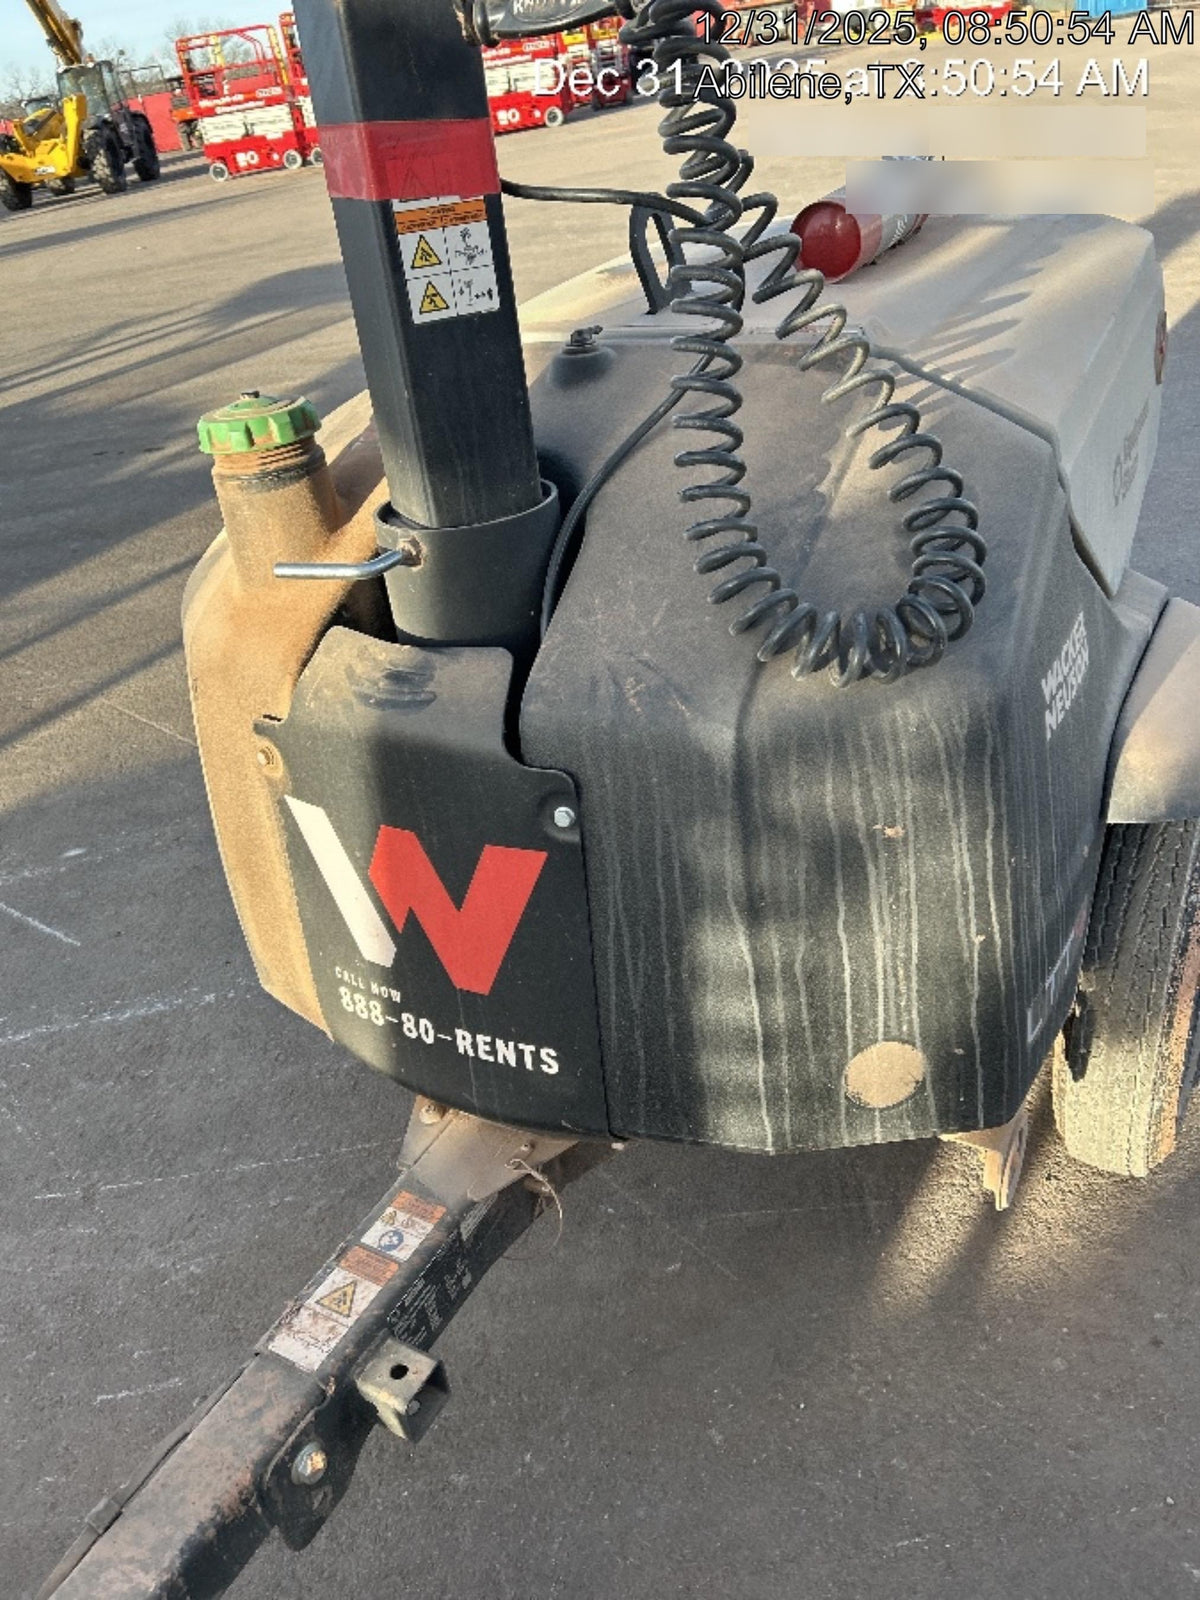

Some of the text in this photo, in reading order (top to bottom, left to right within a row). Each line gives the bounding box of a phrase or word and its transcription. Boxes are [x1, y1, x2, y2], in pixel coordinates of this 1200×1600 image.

[335, 966, 401, 1004] CALL NOW
[338, 985, 560, 1075] 888-80-RENTS
